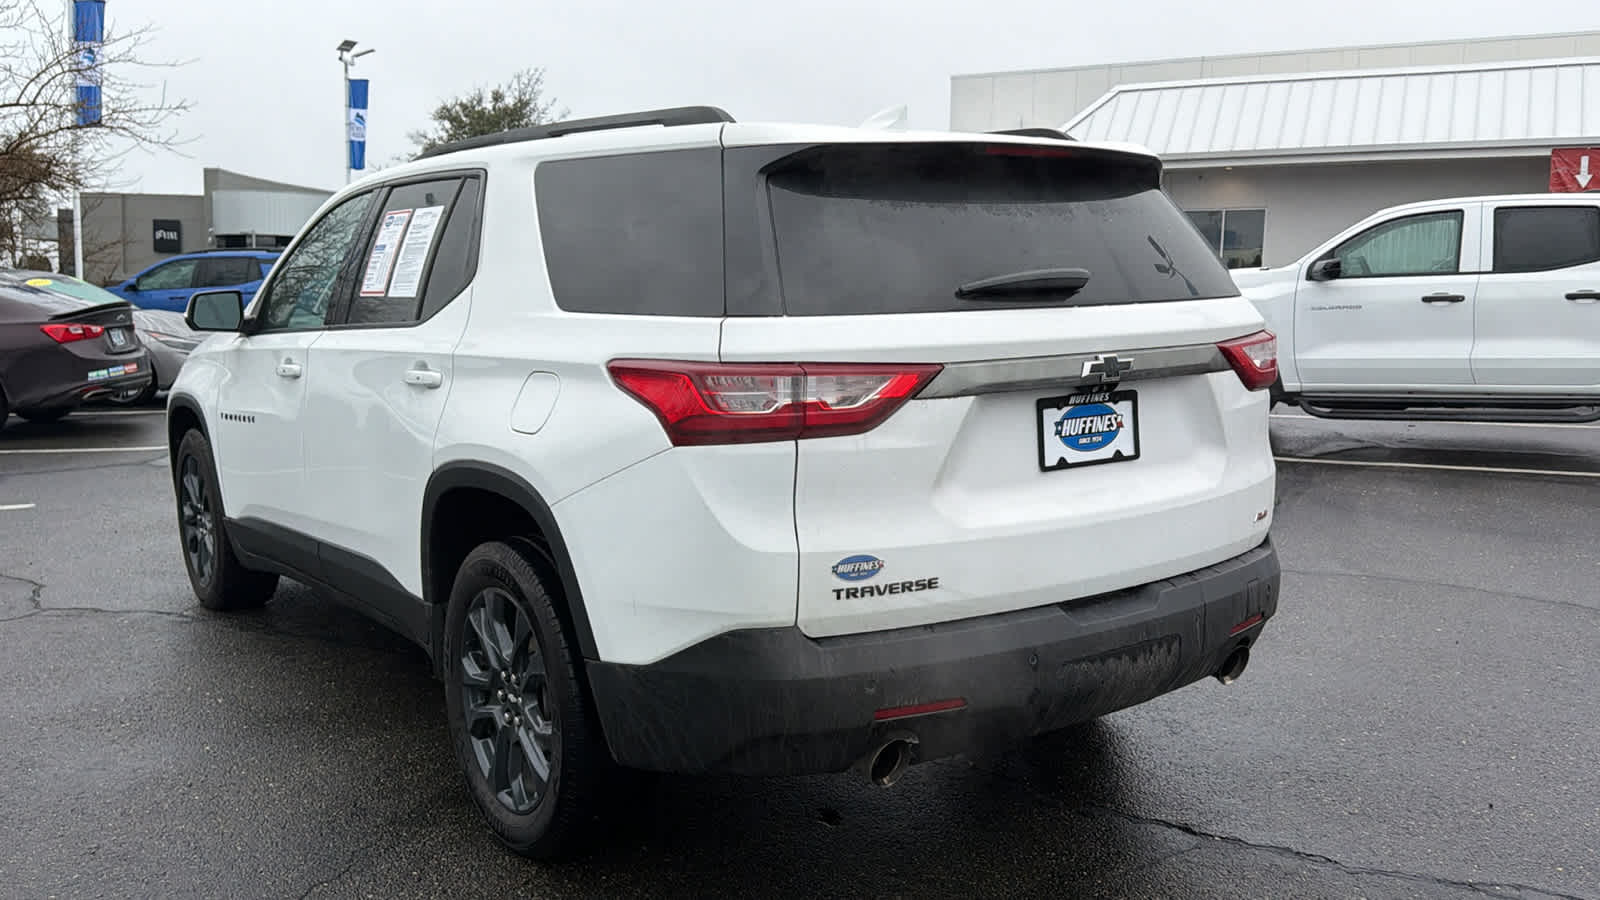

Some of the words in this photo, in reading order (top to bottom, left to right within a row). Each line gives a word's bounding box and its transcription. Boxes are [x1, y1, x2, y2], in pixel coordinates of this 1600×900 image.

[1061, 414, 1118, 437] HUFFINES
[837, 560, 880, 574] HUFFINES
[832, 577, 940, 600] TRAVERSE
